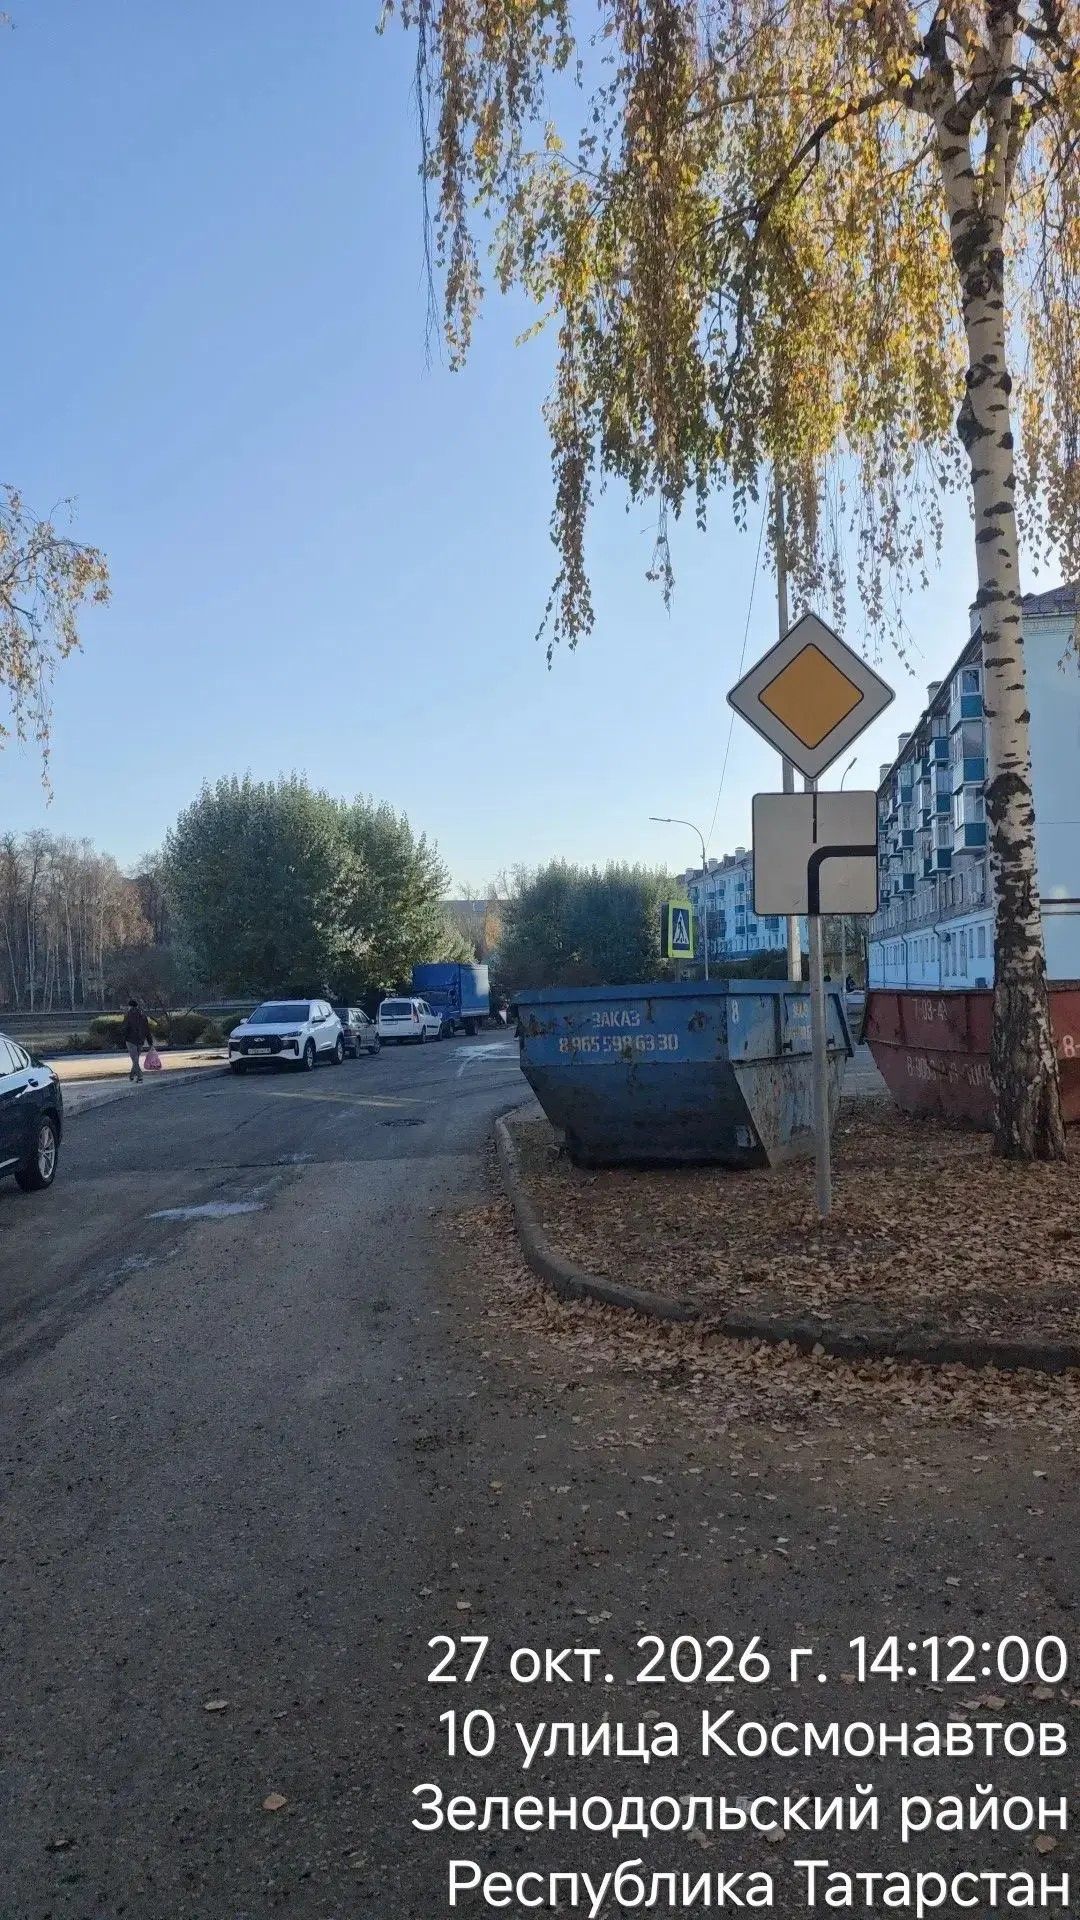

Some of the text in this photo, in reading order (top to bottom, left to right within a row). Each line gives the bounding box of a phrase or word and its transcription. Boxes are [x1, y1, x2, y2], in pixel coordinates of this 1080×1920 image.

[592, 1010, 640, 1027] ЗАКАЗ
[558, 1036, 569, 1052] 8
[572, 1035, 600, 1052] 965
[635, 1034, 655, 1051] 63
[657, 1033, 679, 1051] 30
